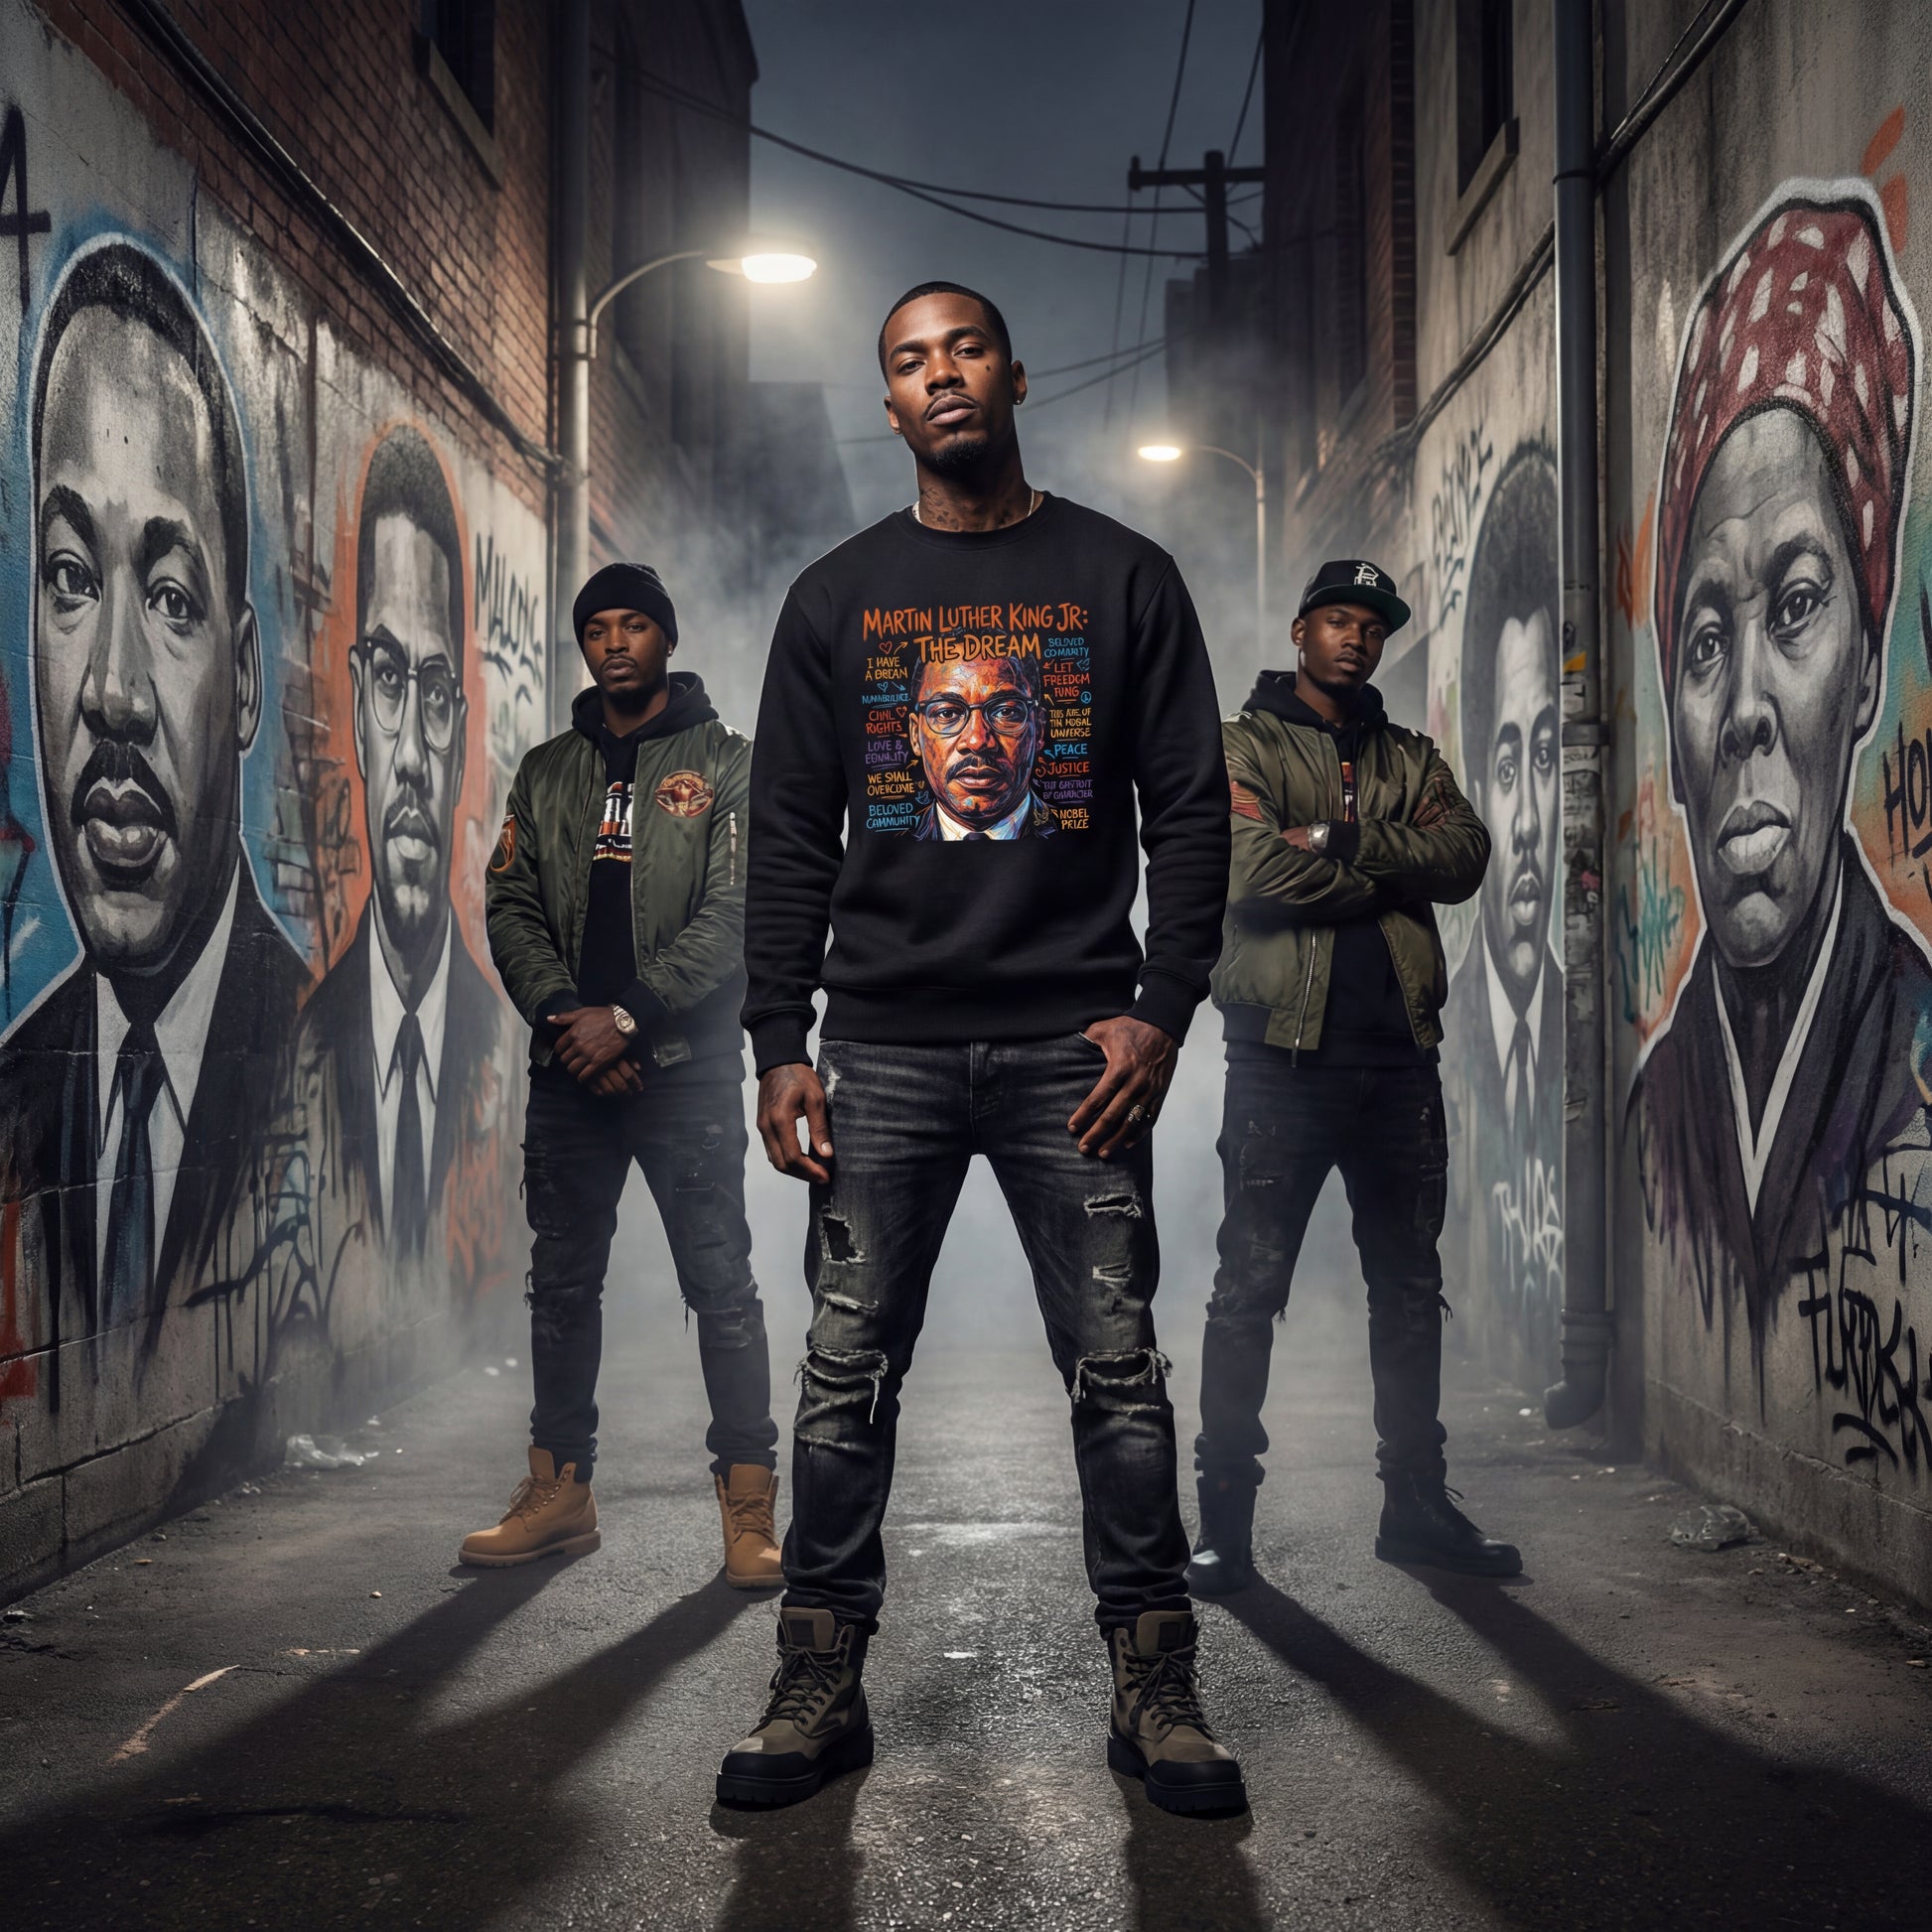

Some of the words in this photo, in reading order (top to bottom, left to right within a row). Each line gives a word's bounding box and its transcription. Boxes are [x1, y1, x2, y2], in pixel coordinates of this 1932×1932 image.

[863, 608, 932, 641] MARTIN
[939, 605, 1004, 632] LUTHER
[1010, 603, 1053, 631] KING
[1056, 603, 1089, 631] JR:
[913, 635, 960, 663] THE
[964, 633, 1041, 661] DREAM
[867, 657, 874, 669] I
[1054, 661, 1073, 673] LET
[865, 670, 873, 681] A
[868, 740, 893, 753] LOVE
[1053, 743, 1088, 757] PEACE
[1047, 761, 1090, 775] JUSTICE
[867, 772, 883, 784] WE
[1883, 722, 1932, 869] HO
